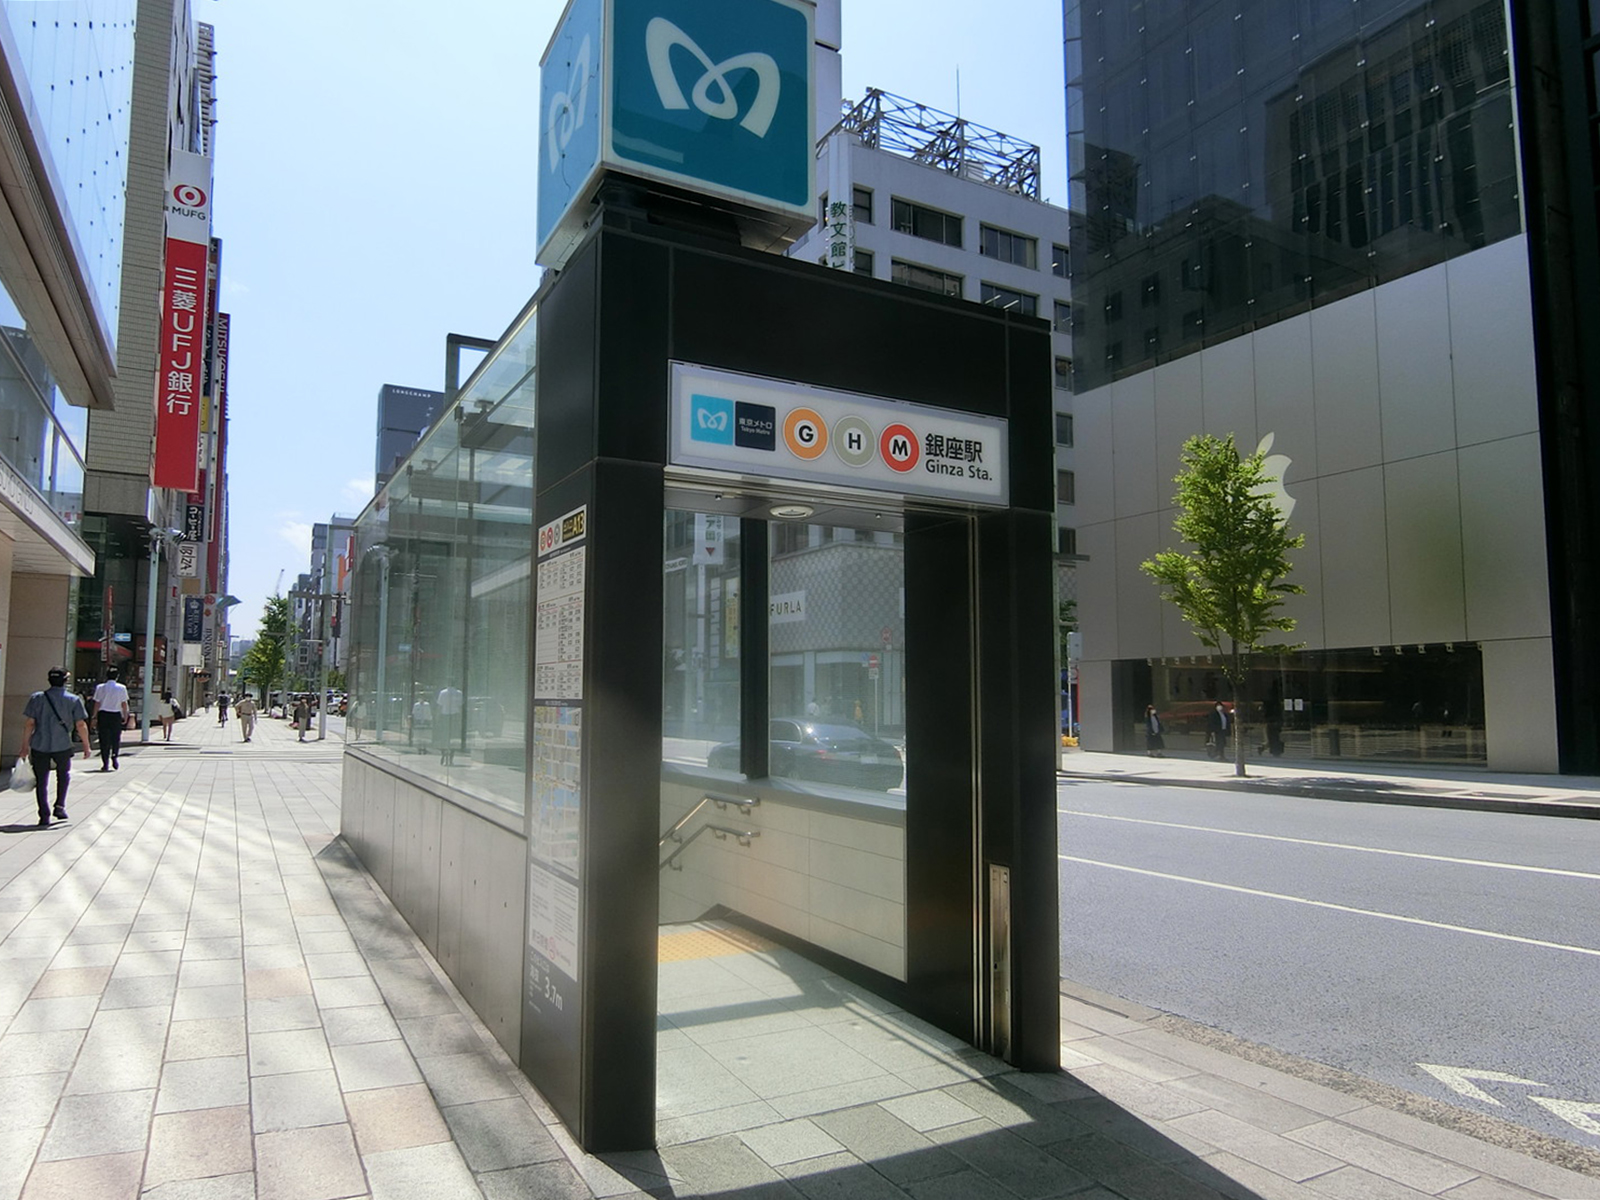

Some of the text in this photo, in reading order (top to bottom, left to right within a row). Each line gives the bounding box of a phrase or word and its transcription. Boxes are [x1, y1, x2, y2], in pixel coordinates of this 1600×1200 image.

[171, 205, 206, 221] MUFG
[166, 266, 198, 416] 三菱UFJ銀行
[799, 424, 814, 443] G
[848, 433, 862, 450] H
[892, 439, 909, 457] M
[925, 433, 983, 464] 銀座駅
[925, 458, 993, 481] Ginza Sta.
[572, 512, 585, 536] A13
[769, 601, 802, 616] FURLA
[544, 976, 563, 1011] 3.7m
